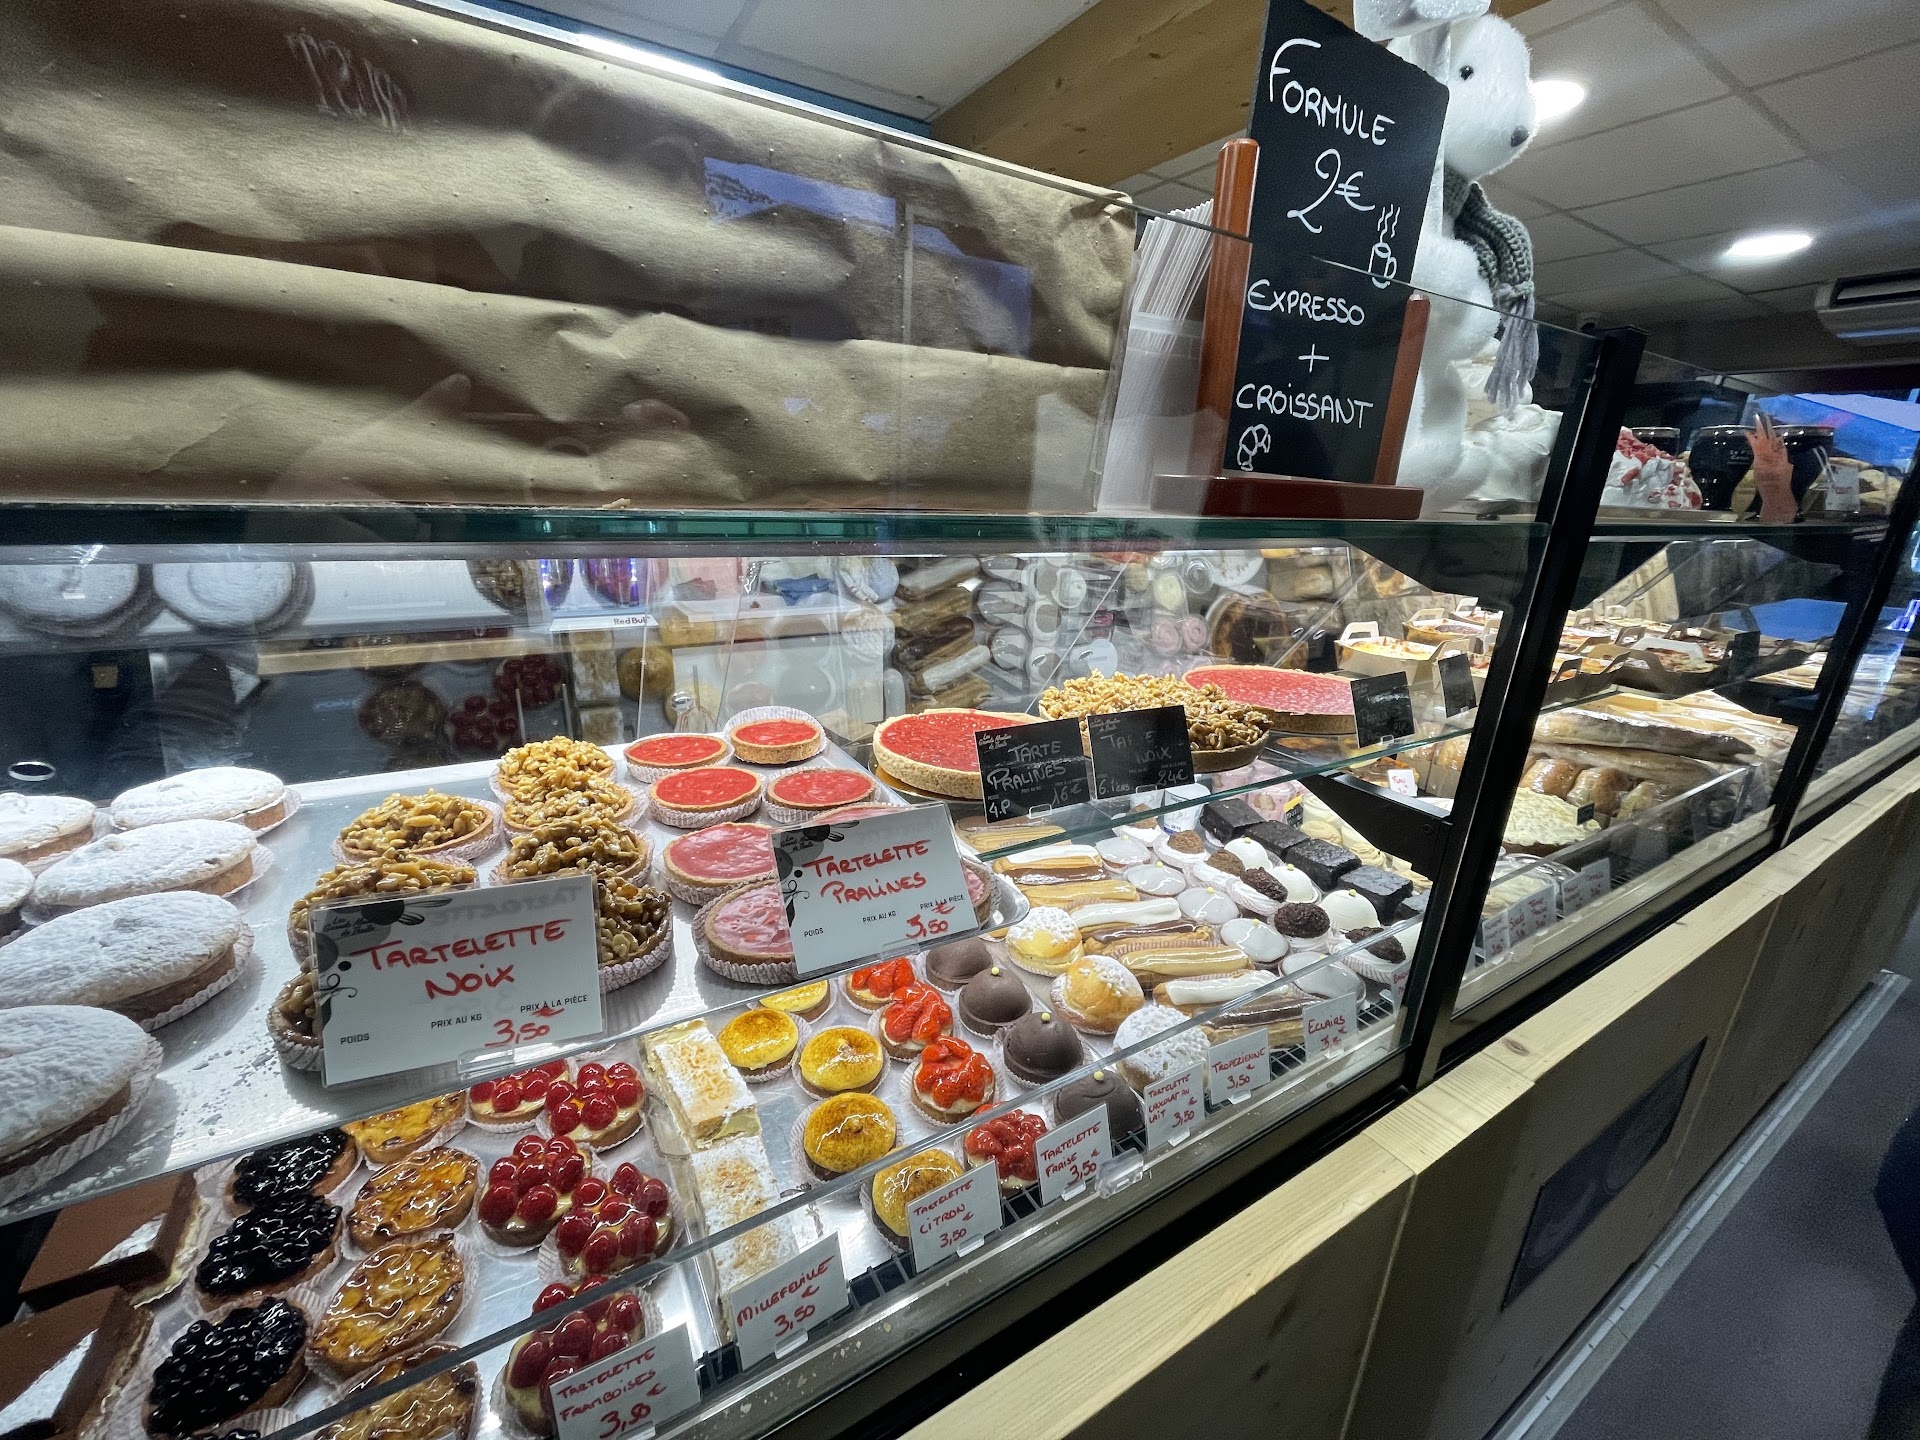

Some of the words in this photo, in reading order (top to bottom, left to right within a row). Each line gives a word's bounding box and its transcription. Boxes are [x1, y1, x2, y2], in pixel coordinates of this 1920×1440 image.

[1270, 38, 1395, 146] FORMULE
[1287, 148, 1375, 234] 2€
[1247, 279, 1364, 326] EXPRESSO
[1007, 741, 1061, 762] TARTE
[987, 762, 1066, 791] PRALINES
[800, 839, 931, 878] TARTELETTE
[804, 927, 824, 938] POIDS
[906, 914, 949, 939] 3,50
[350, 919, 572, 970] TARTELETTE
[520, 1003, 540, 1013] PRIX
[551, 999, 562, 1008] LA
[430, 1018, 453, 1030] PRIX
[455, 1016, 468, 1026] AU
[470, 1013, 482, 1023] KG
[484, 1019, 551, 1048] 3,50
[340, 1033, 370, 1045] POIDS
[1148, 1073, 1191, 1098] TARTELETTE
[1227, 1074, 1251, 1090] 3,50
[1171, 1110, 1195, 1128] 3,50
[1040, 1121, 1102, 1161] TARTELETTE
[1067, 1160, 1097, 1186] 3,50
[913, 1179, 974, 1217] TARTELETTE
[940, 1228, 967, 1249] 3,50
[773, 1304, 816, 1337] 3,50
[556, 1345, 656, 1399] TARTELETTE
